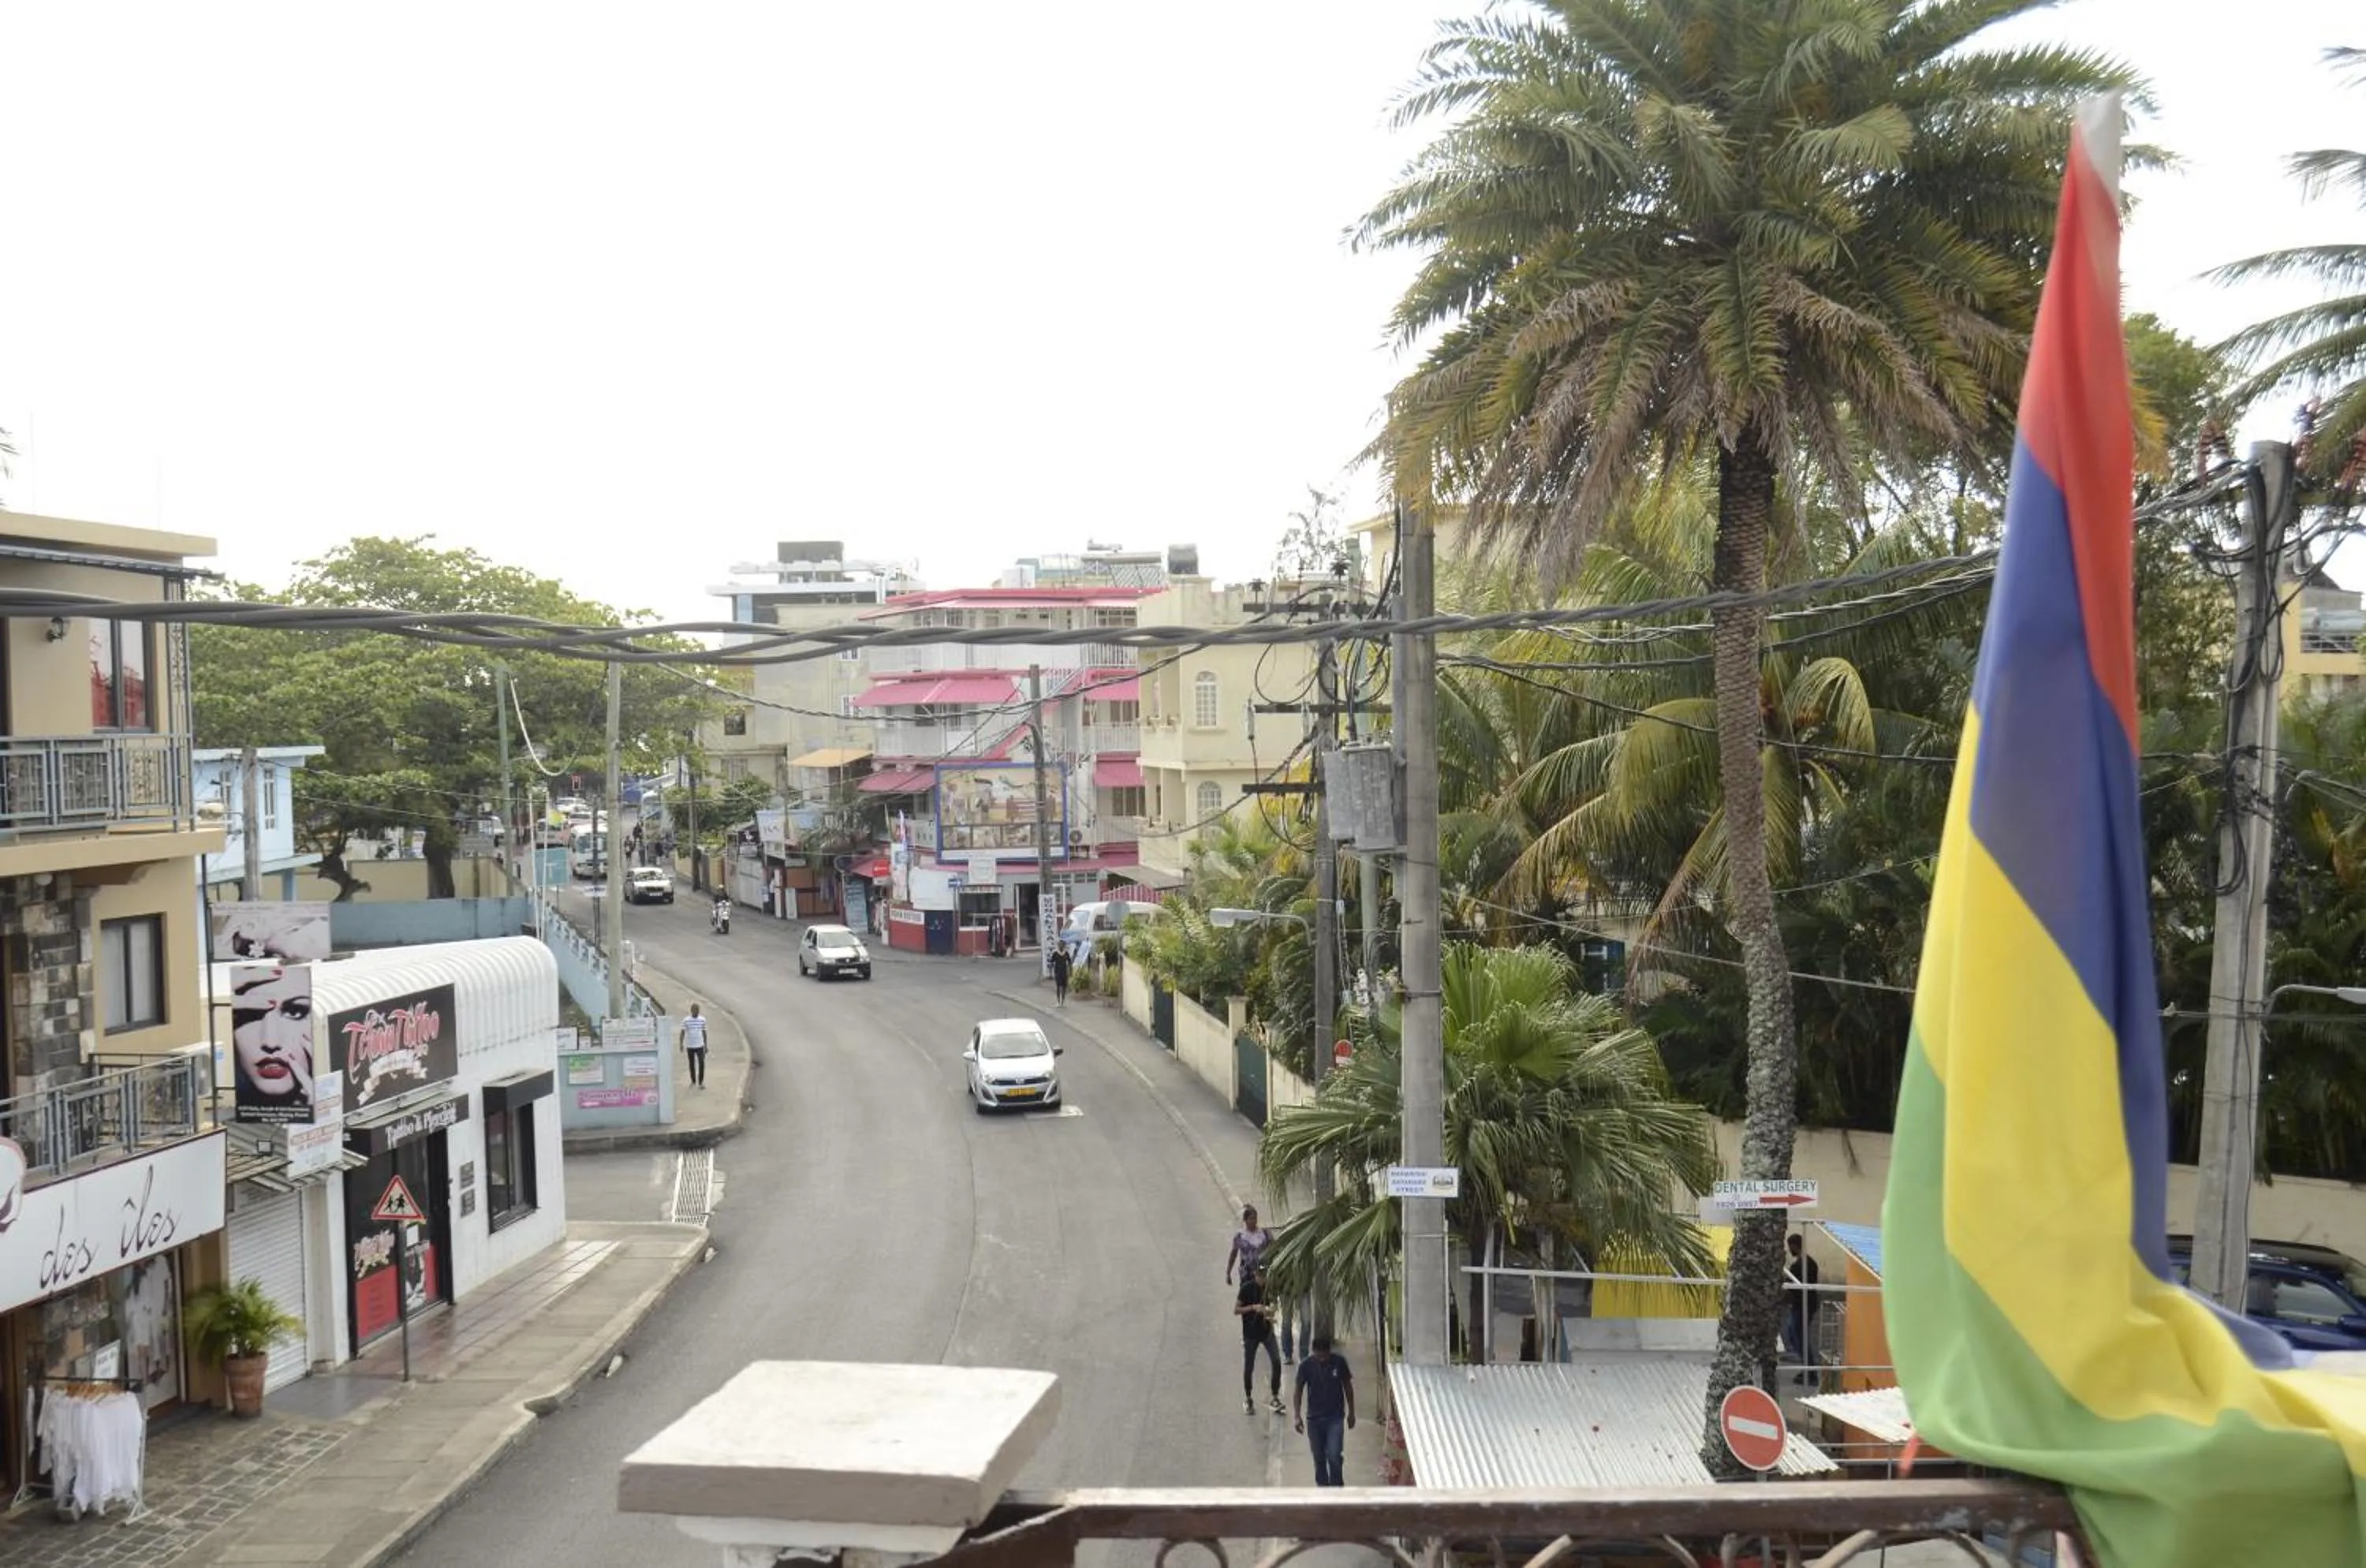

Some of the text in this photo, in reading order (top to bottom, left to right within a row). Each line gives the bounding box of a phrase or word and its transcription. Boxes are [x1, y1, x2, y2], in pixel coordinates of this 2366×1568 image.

[1715, 1181, 1816, 1193] DENTAL SURGERY
[40, 1163, 182, 1289] des îles
